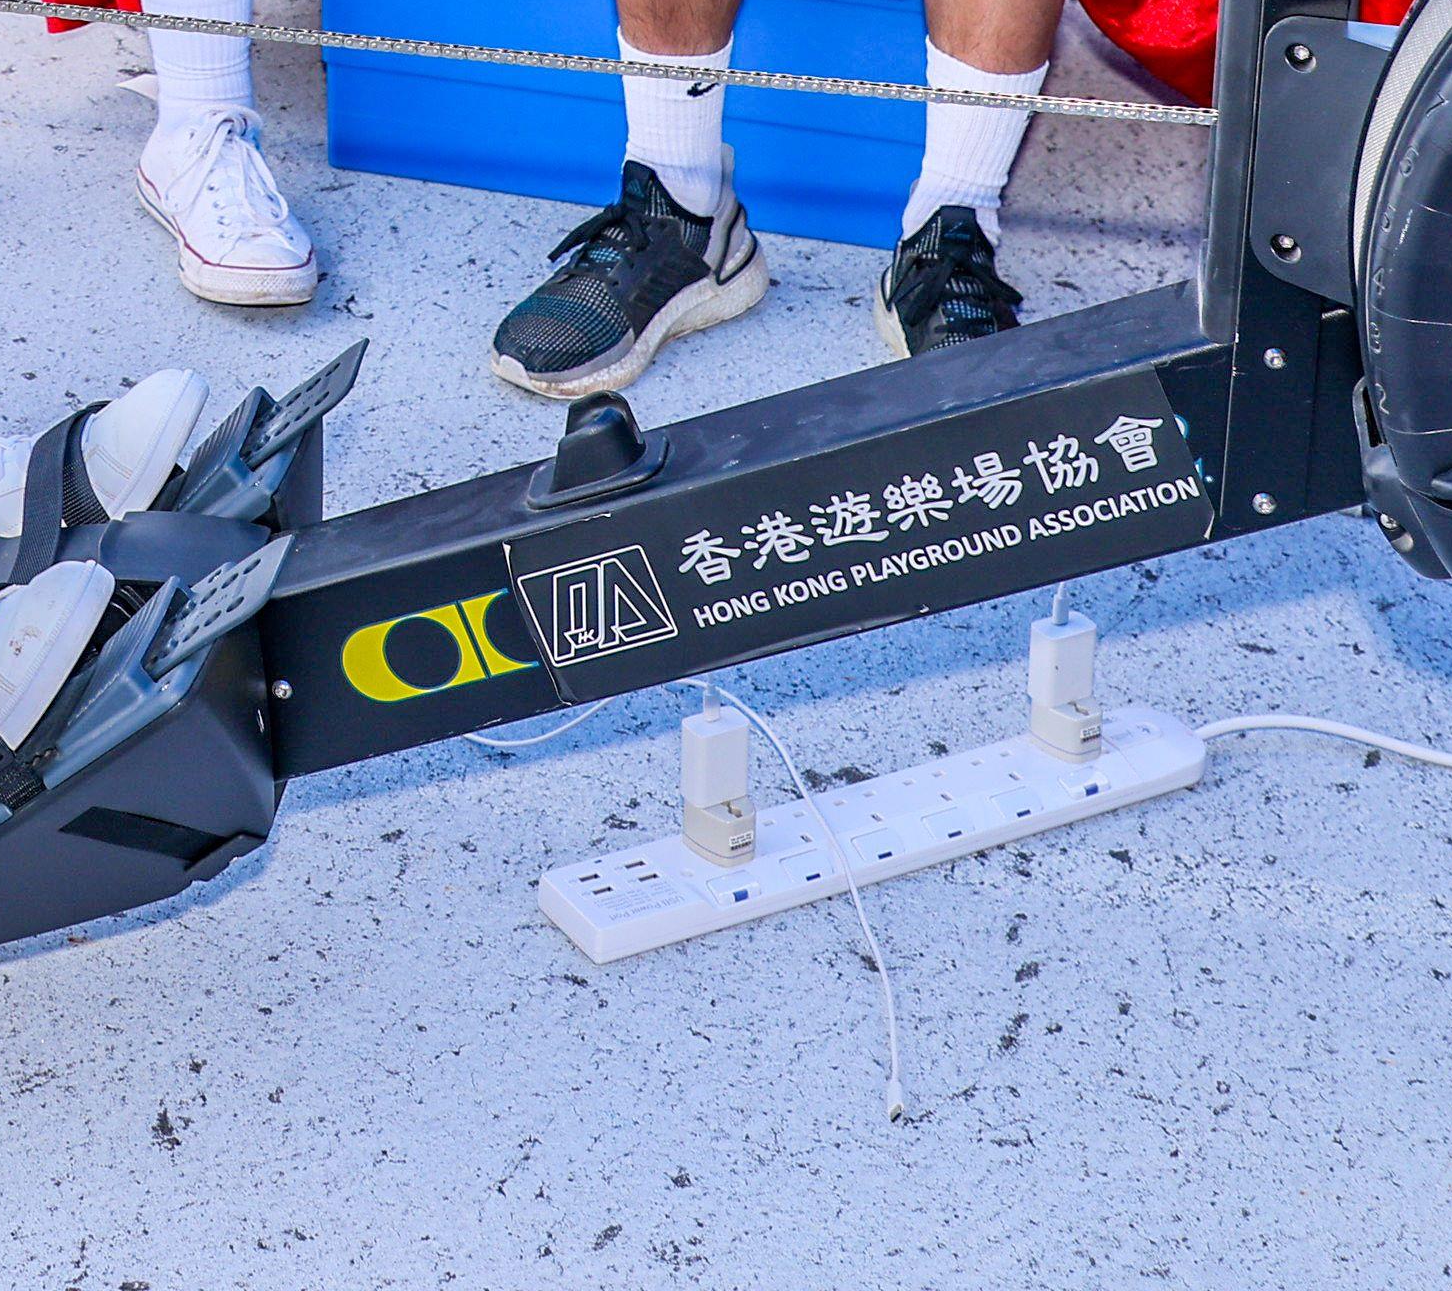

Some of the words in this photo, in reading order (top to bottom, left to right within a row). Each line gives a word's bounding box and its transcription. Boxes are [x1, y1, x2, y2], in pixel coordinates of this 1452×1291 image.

[678, 414, 1165, 586] 香港遊樂場協會
[693, 594, 770, 629] HONG
[773, 570, 847, 608] KONG
[851, 525, 1023, 586] PLAYGROUND
[1028, 476, 1201, 540] ASSOCIATION
